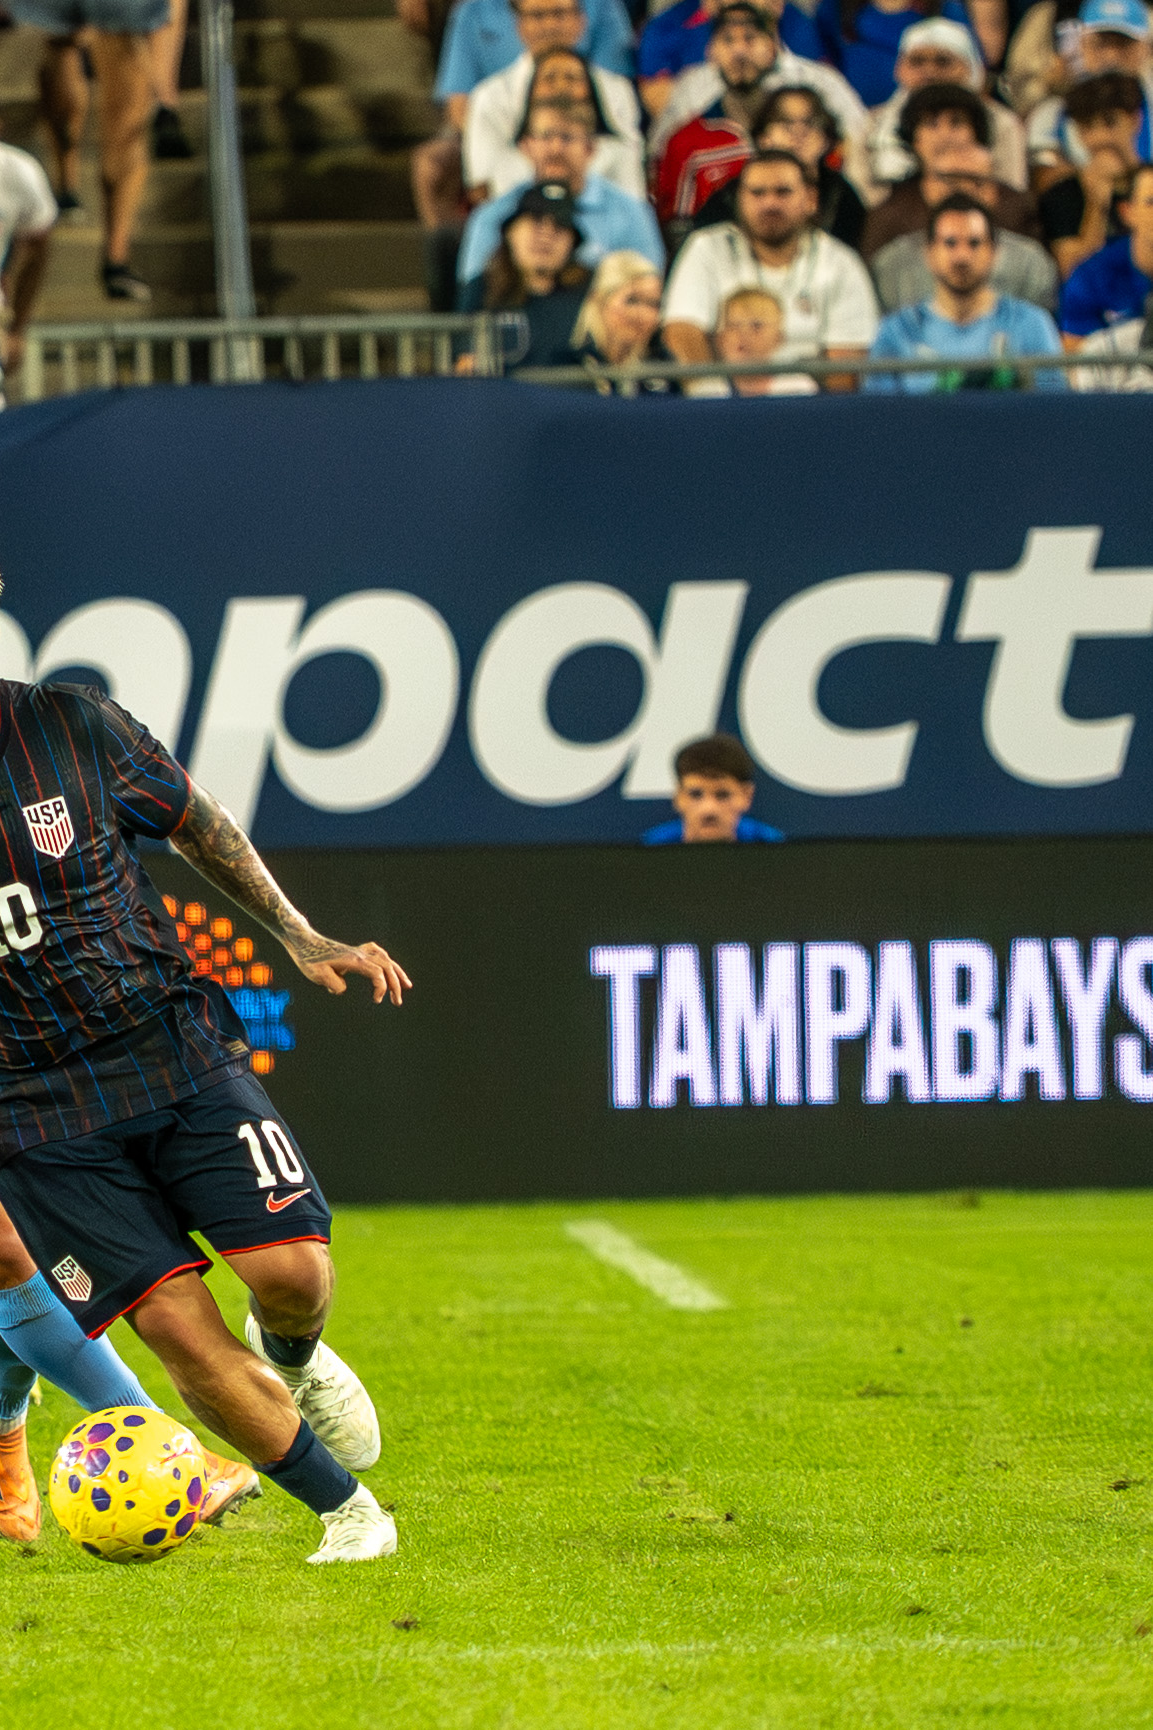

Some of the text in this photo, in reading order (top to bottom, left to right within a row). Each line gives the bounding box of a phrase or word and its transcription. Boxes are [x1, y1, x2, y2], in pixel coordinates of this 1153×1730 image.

[26, 800, 65, 826] USA
[238, 1120, 304, 1189] 10
[53, 1258, 77, 1281] USA
